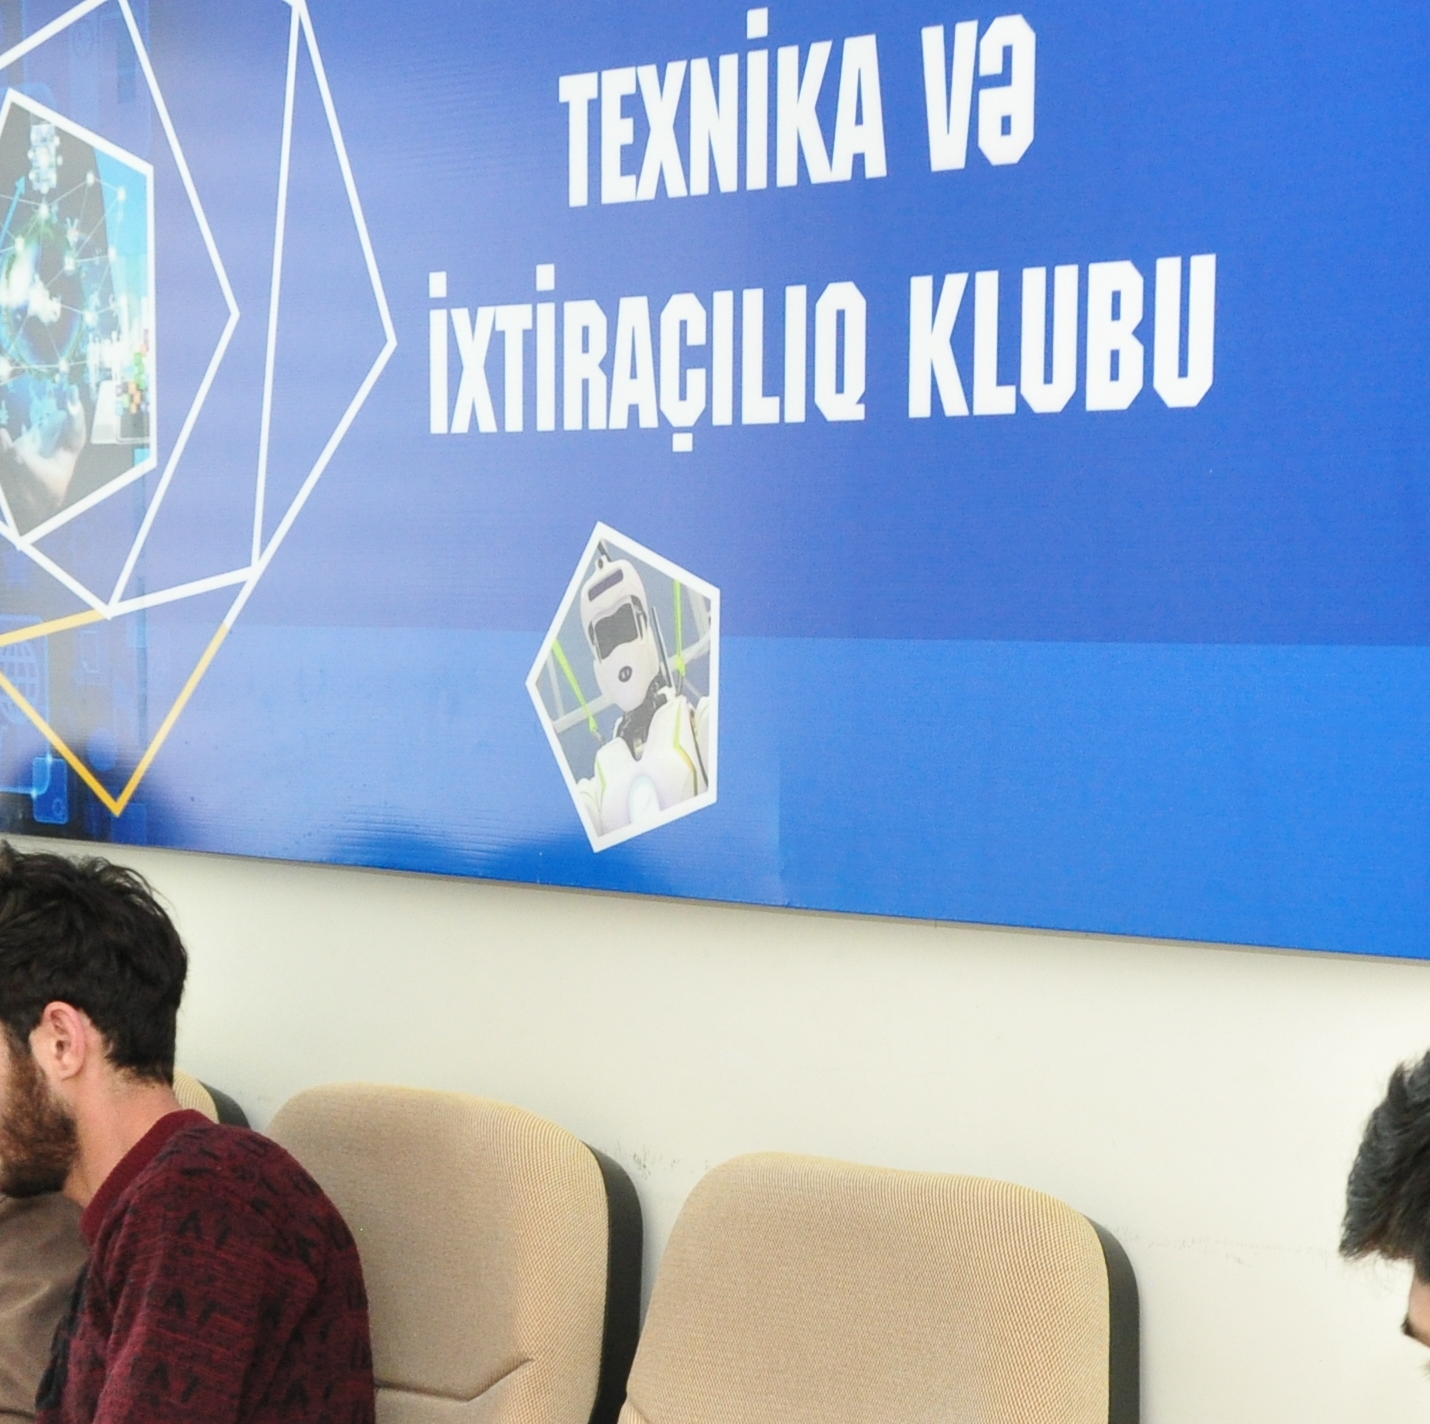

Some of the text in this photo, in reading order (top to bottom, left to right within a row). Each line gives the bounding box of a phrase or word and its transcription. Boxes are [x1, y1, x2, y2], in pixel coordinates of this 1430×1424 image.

[558, 7, 1036, 207] TEXNİKA VƏ
[428, 254, 1216, 452] İXTİRAÇILIQ KLUBU
